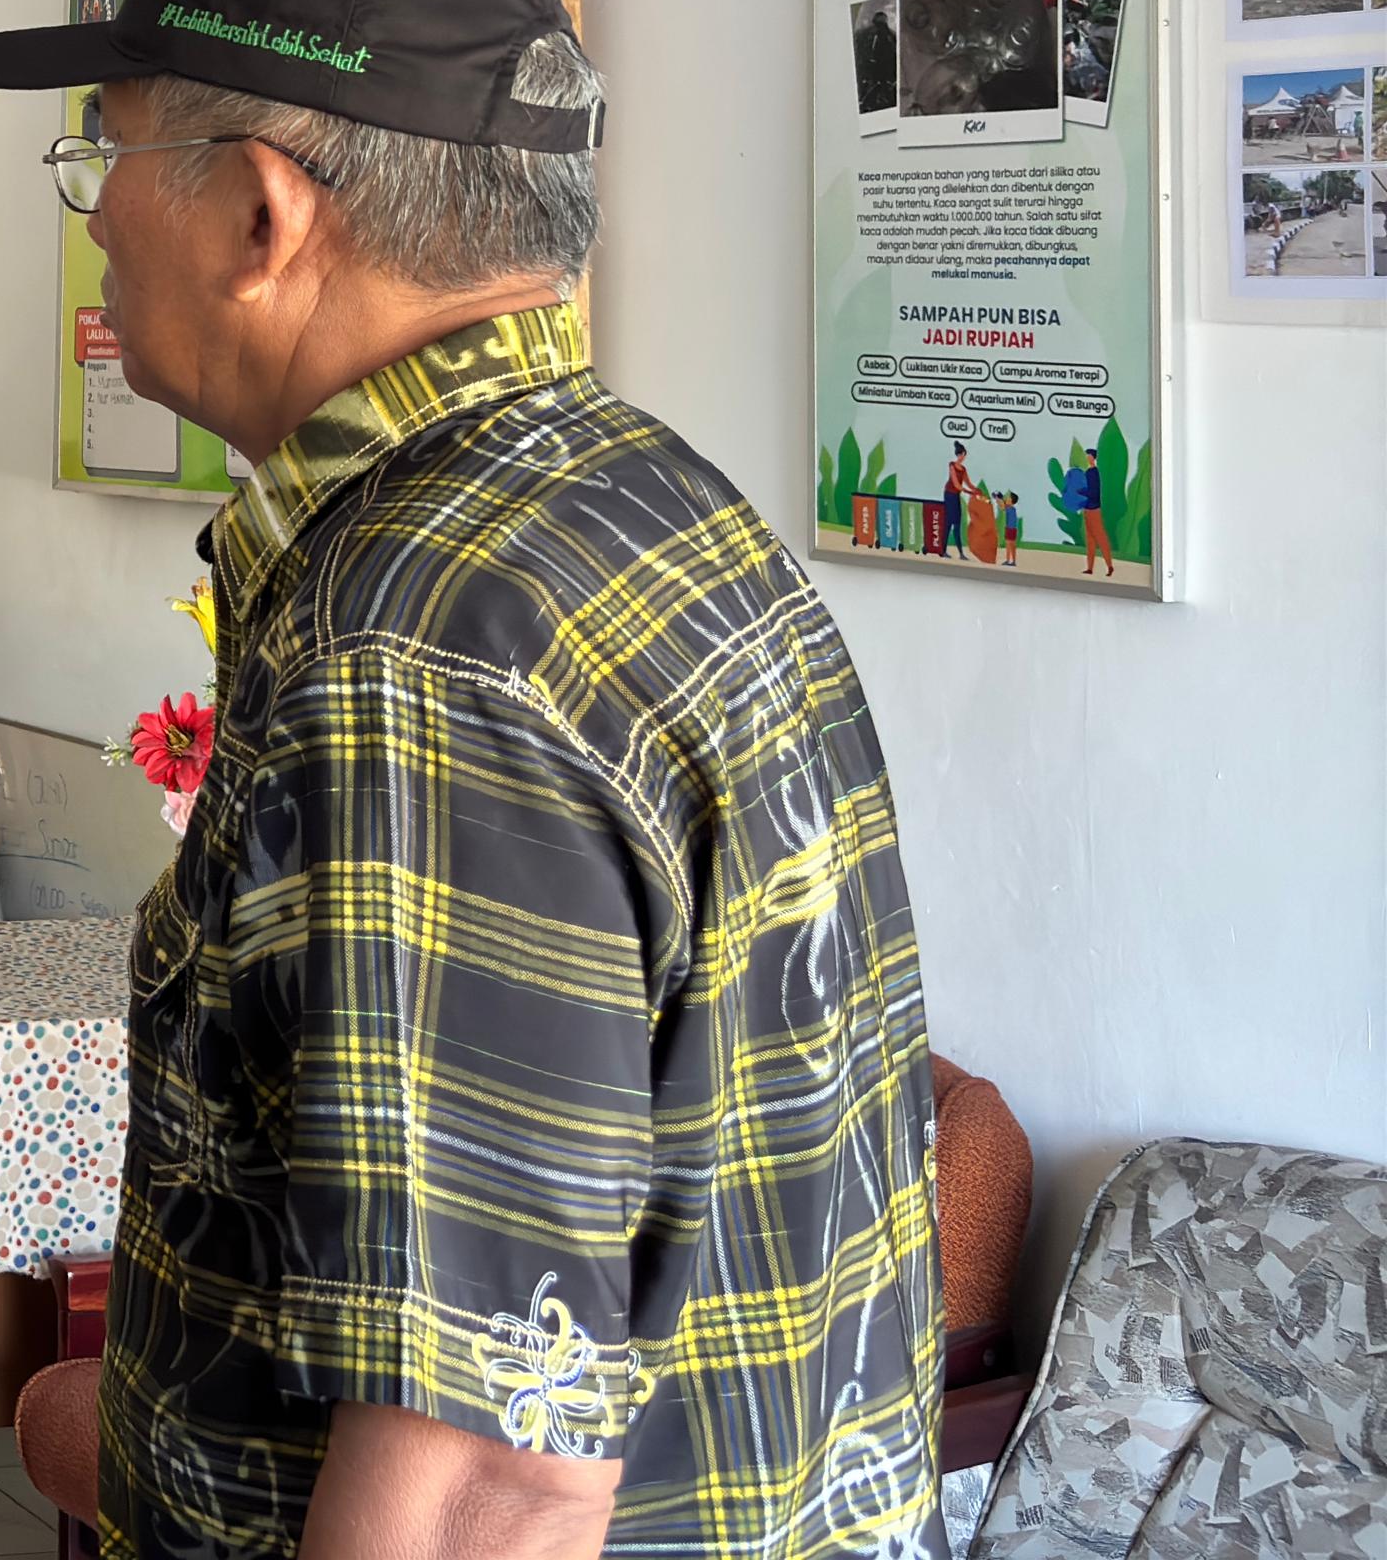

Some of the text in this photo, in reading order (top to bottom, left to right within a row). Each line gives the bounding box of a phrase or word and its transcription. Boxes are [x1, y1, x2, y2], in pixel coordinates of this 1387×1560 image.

[859, 173, 880, 182] Kaca
[882, 172, 932, 182] merupakan
[935, 170, 964, 180] bahan
[966, 170, 989, 181] yang
[992, 168, 1027, 179] terbuat
[1029, 167, 1048, 177] dari
[1077, 167, 1100, 176] atau
[887, 184, 915, 195] kuarsa
[918, 185, 940, 197] yang
[991, 183, 1009, 193] dan
[1012, 182, 1053, 193] dibentuk
[1056, 181, 1094, 194] dengan
[873, 199, 893, 209] suhu
[934, 198, 957, 208] Kaca
[959, 198, 990, 210] sangat
[993, 197, 1012, 207] sulit
[1049, 196, 1083, 209] hingga
[923, 211, 949, 221] waktu
[1027, 211, 1053, 221] Salah
[1056, 211, 1077, 221] satu
[1080, 210, 1101, 221] sifat
[860, 226, 1097, 238] kaca adalah mudah Jika kaca tidak dibuang
[877, 240, 910, 253] dengan
[912, 241, 938, 250] benar
[867, 255, 1090, 268] maupun didaur maka pecahannya dapat
[932, 269, 969, 279] melukai
[899, 306, 1061, 326] SAMPAH PUN BISA
[923, 329, 1034, 349] JADI RUPIAH
[864, 360, 890, 371] Asbak
[906, 362, 982, 375] Lukisan Ukir Kaca
[1000, 366, 1100, 382] Lampu Aroma Terapi
[859, 386, 893, 397] Miniatur
[928, 391, 950, 401] Kaca
[968, 394, 1035, 407] Aquarium Mini
[1056, 399, 1108, 414] Vas Bunga
[948, 422, 968, 432] Guci
[988, 424, 1008, 434] Trofi
